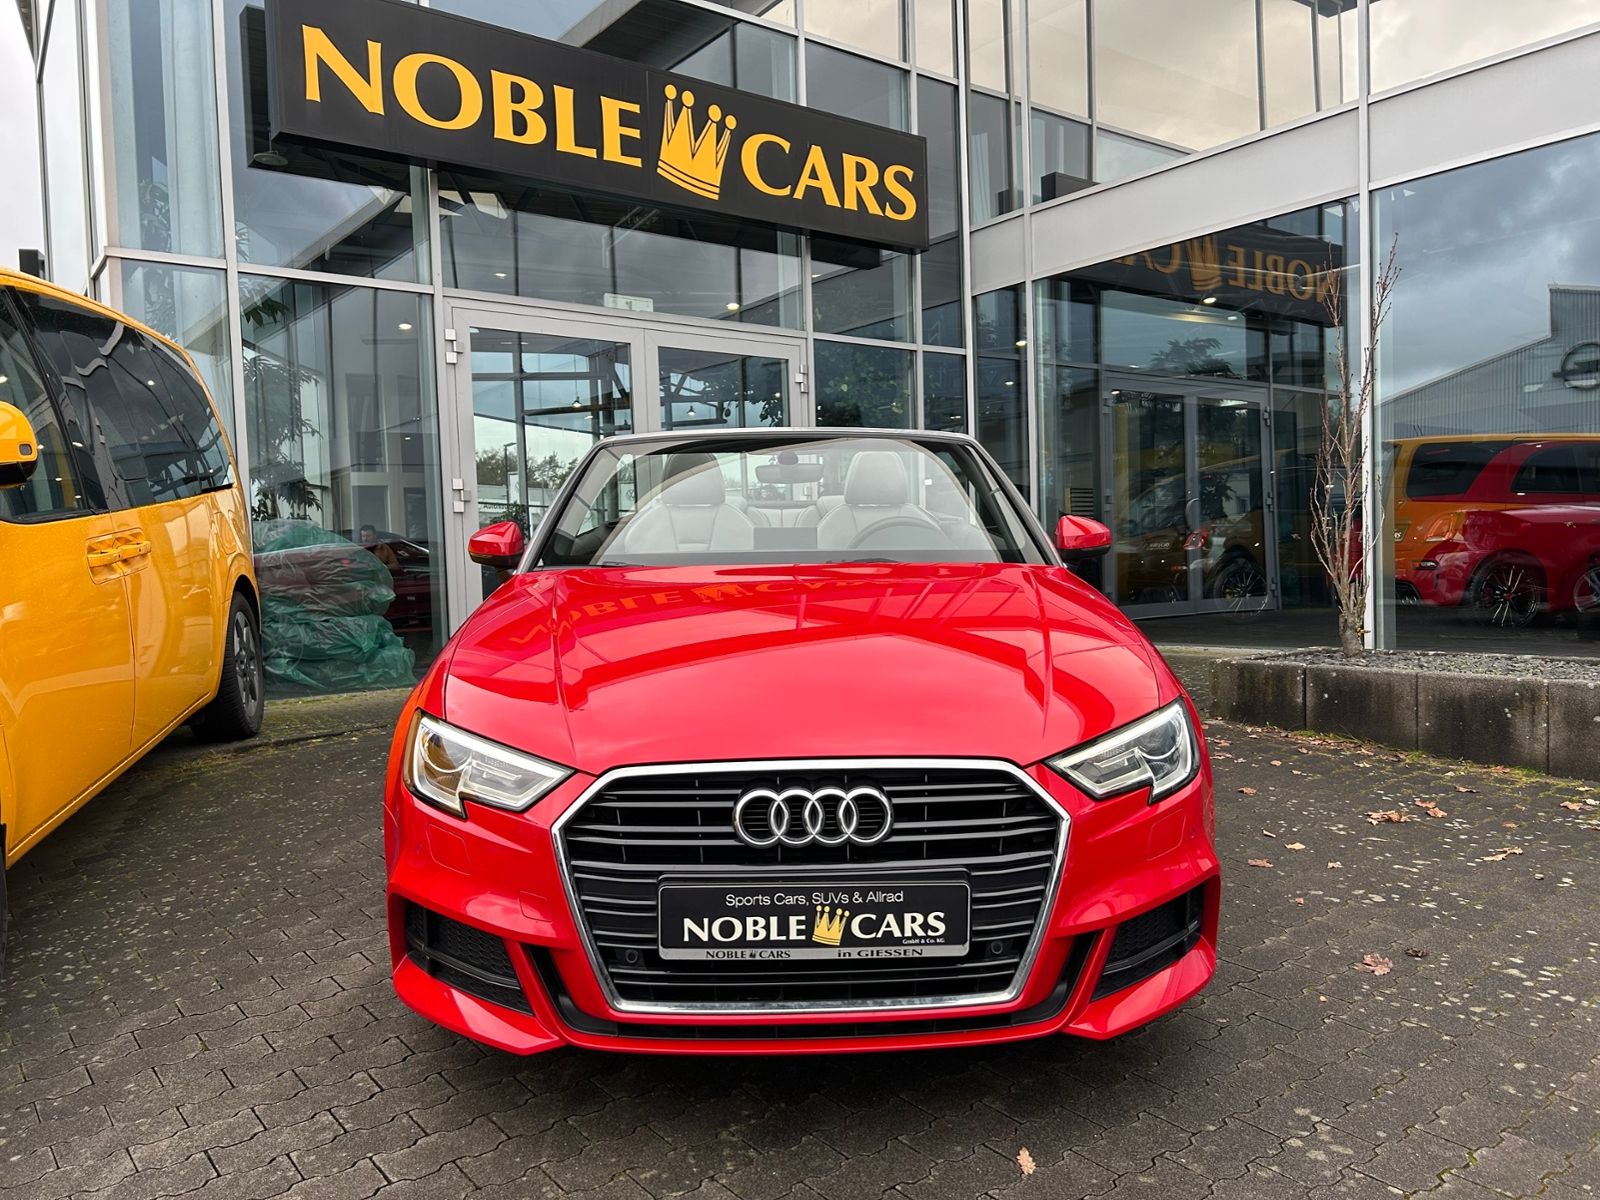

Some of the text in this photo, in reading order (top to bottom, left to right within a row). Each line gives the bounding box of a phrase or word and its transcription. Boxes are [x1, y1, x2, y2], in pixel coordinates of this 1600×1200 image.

[302, 25, 917, 221] NOBLE CARS
[725, 890, 904, 908] Sports Cars, SUVs & Allrad
[683, 911, 946, 942] NOBLE CARS
[705, 950, 791, 959] NOBLE CARS
[838, 948, 923, 958] in GIESSEN
